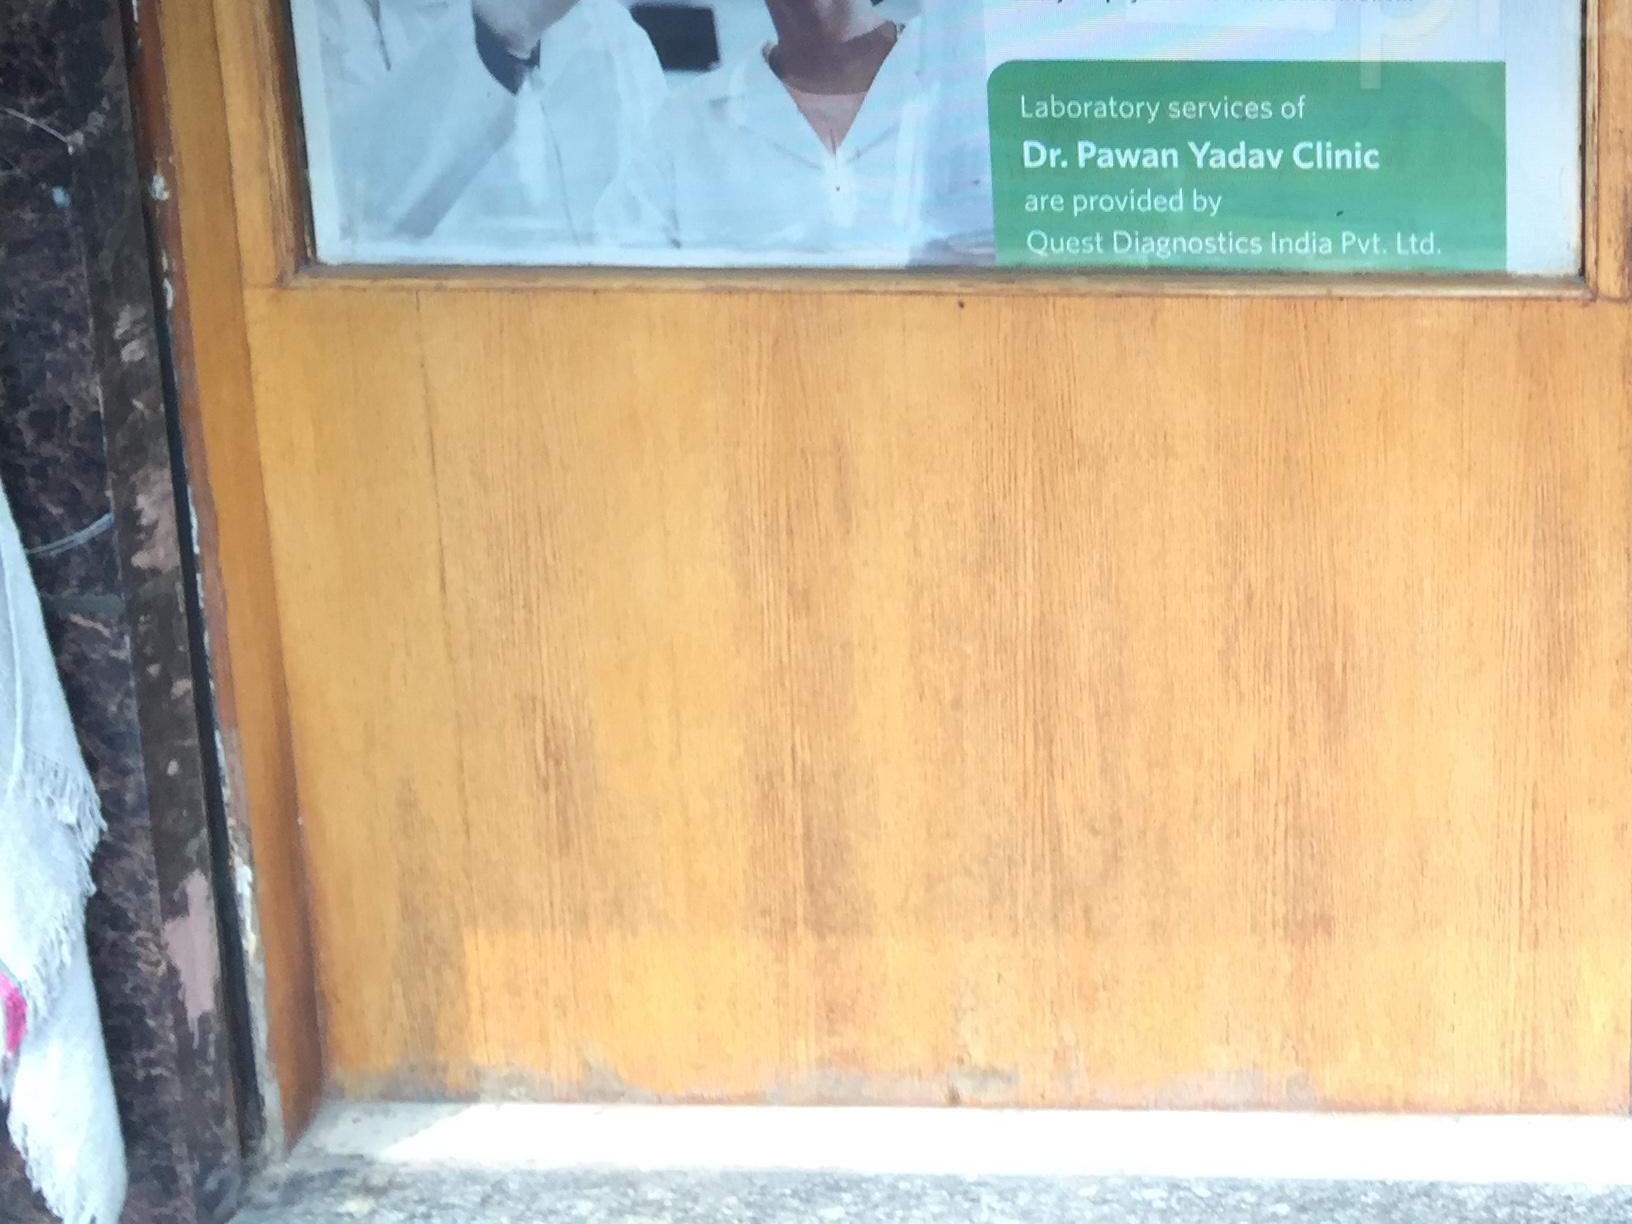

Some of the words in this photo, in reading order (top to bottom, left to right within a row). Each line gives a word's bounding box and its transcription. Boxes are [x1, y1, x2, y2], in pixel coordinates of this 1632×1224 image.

[1019, 94, 1160, 123] Laboratory
[1168, 97, 1273, 120] services
[1281, 94, 1306, 119] of
[1022, 140, 1068, 170] Dr.
[1077, 141, 1179, 169] Pawan
[1188, 141, 1284, 170] Yadav
[1292, 141, 1380, 170] Clinic
[1024, 192, 1064, 213] are
[1073, 188, 1183, 217] provided
[1192, 188, 1222, 217] by
[1027, 231, 1103, 257] Quest
[1112, 230, 1262, 259] Diagnostics
[1271, 230, 1332, 256] India
[1341, 231, 1387, 256] Pvt.
[1397, 230, 1442, 256] Ltd.
